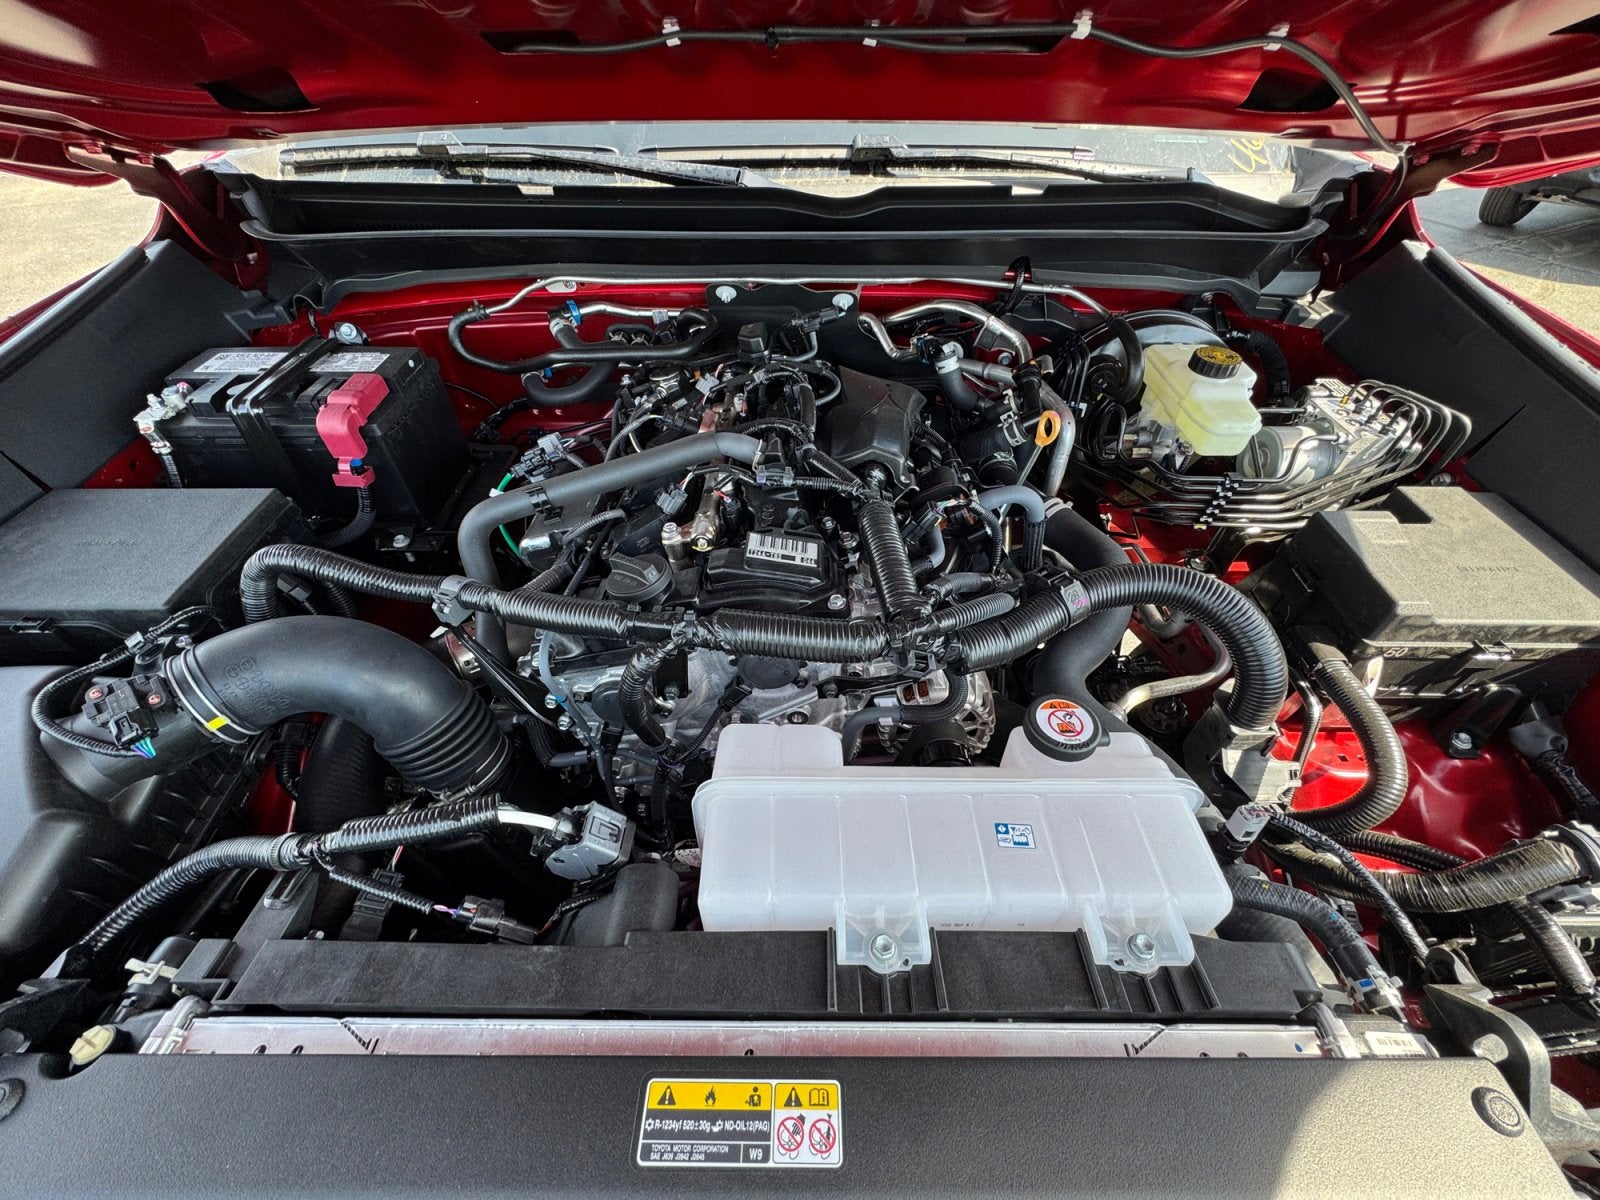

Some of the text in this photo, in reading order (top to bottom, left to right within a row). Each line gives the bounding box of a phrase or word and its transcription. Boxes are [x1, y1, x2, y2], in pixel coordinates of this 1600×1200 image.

[655, 1119, 770, 1133] R-1234yf 520±30g ND-OIL12(PAG)
[651, 1144, 729, 1153] TOYOTA MOTOR CORPORATION
[650, 1152, 661, 1160] SAE
[749, 1148, 763, 1161] W9
